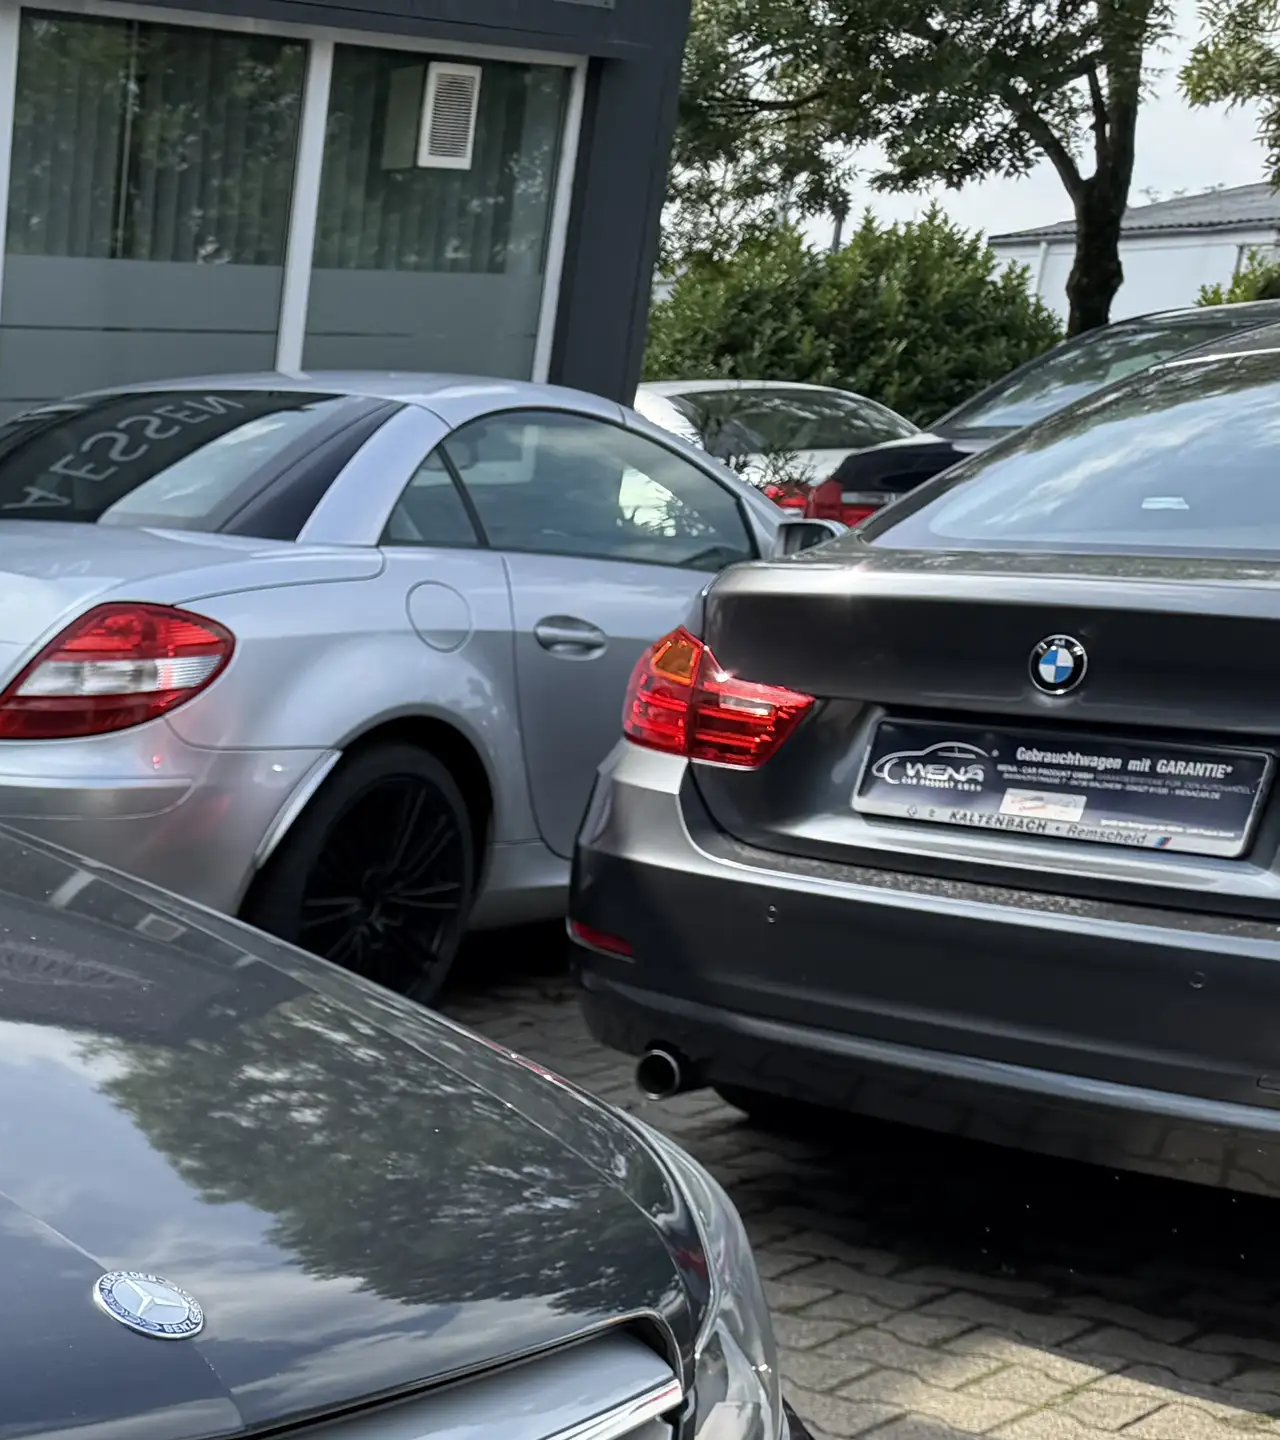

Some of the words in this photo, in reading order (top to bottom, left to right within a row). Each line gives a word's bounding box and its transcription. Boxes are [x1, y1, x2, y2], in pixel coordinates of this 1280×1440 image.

[1016, 746, 1122, 771] Gebrauchtwagen
[1128, 758, 1151, 772] mit
[948, 810, 1048, 833] KALTENBACH
[1067, 824, 1147, 845] Remscheid
[163, 1319, 197, 1333] BENZ
